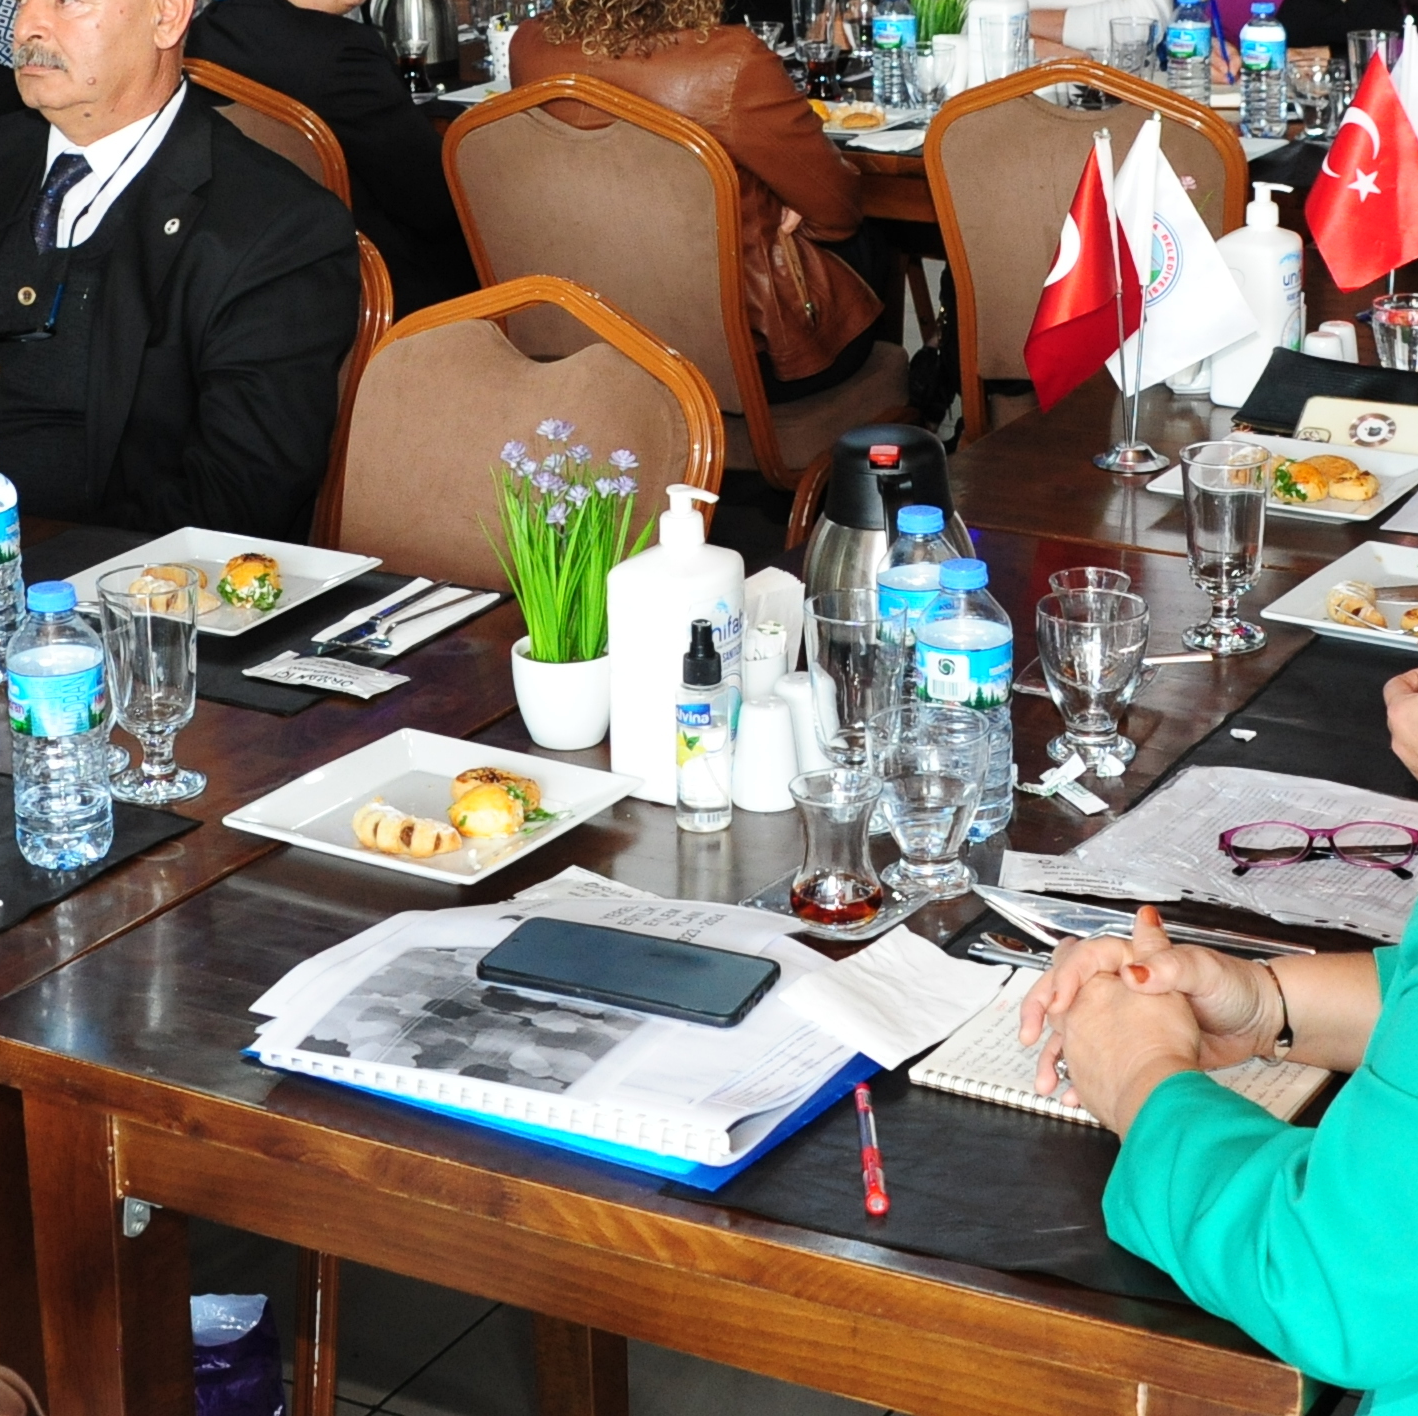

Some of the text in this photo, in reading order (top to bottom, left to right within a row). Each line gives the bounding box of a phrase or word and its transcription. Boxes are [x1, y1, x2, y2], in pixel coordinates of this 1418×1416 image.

[1147, 234, 1175, 299] BELEDİYESİ
[712, 608, 743, 642] nifab
[643, 908, 683, 927] EYLEM
